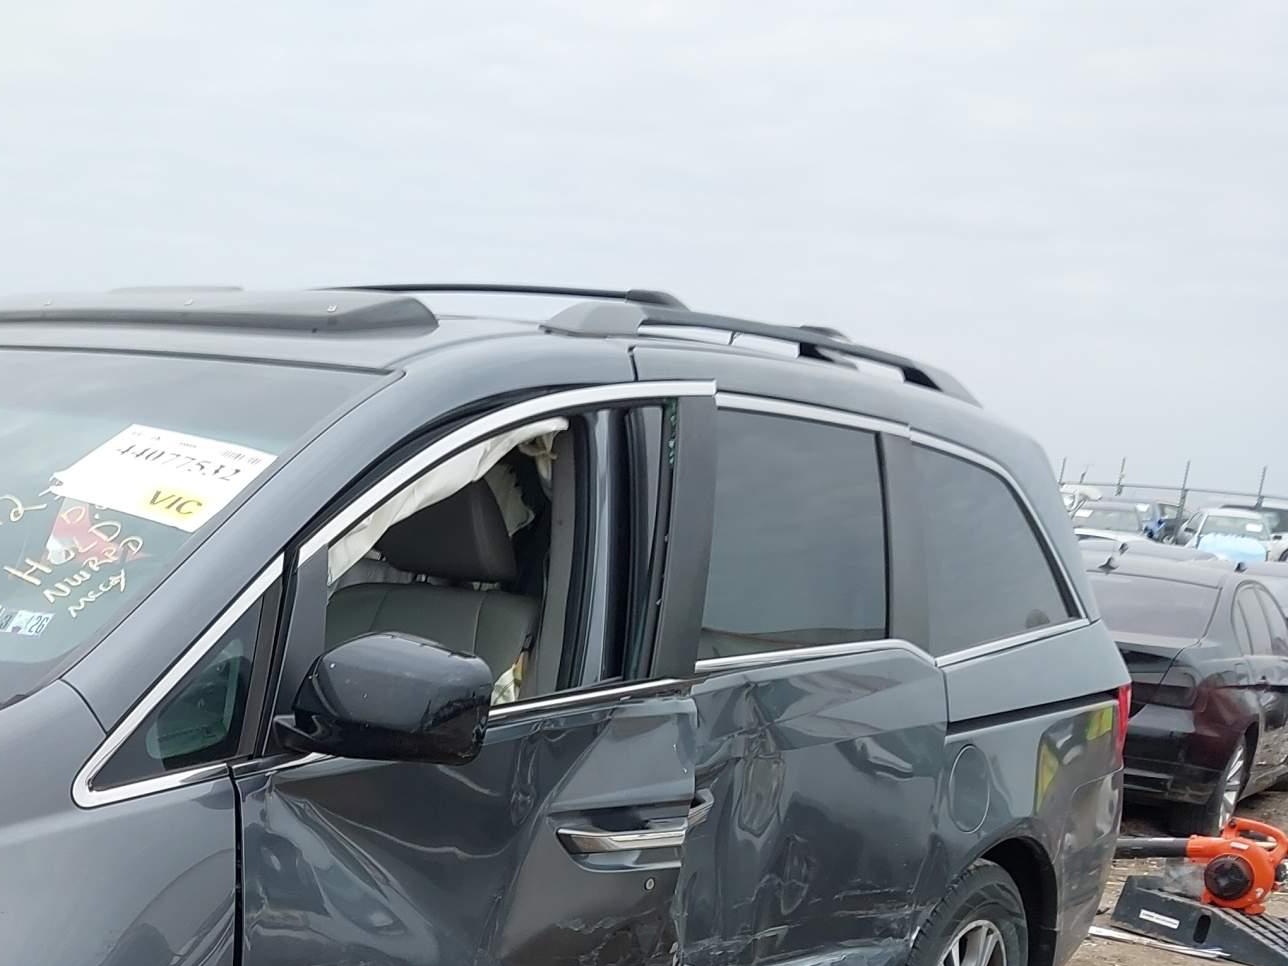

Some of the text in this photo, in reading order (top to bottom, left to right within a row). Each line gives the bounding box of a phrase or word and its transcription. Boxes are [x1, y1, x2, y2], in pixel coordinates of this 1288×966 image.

[149, 489, 203, 516] VIC
[3, 520, 122, 586] HOLD
[27, 616, 49, 634] 26
